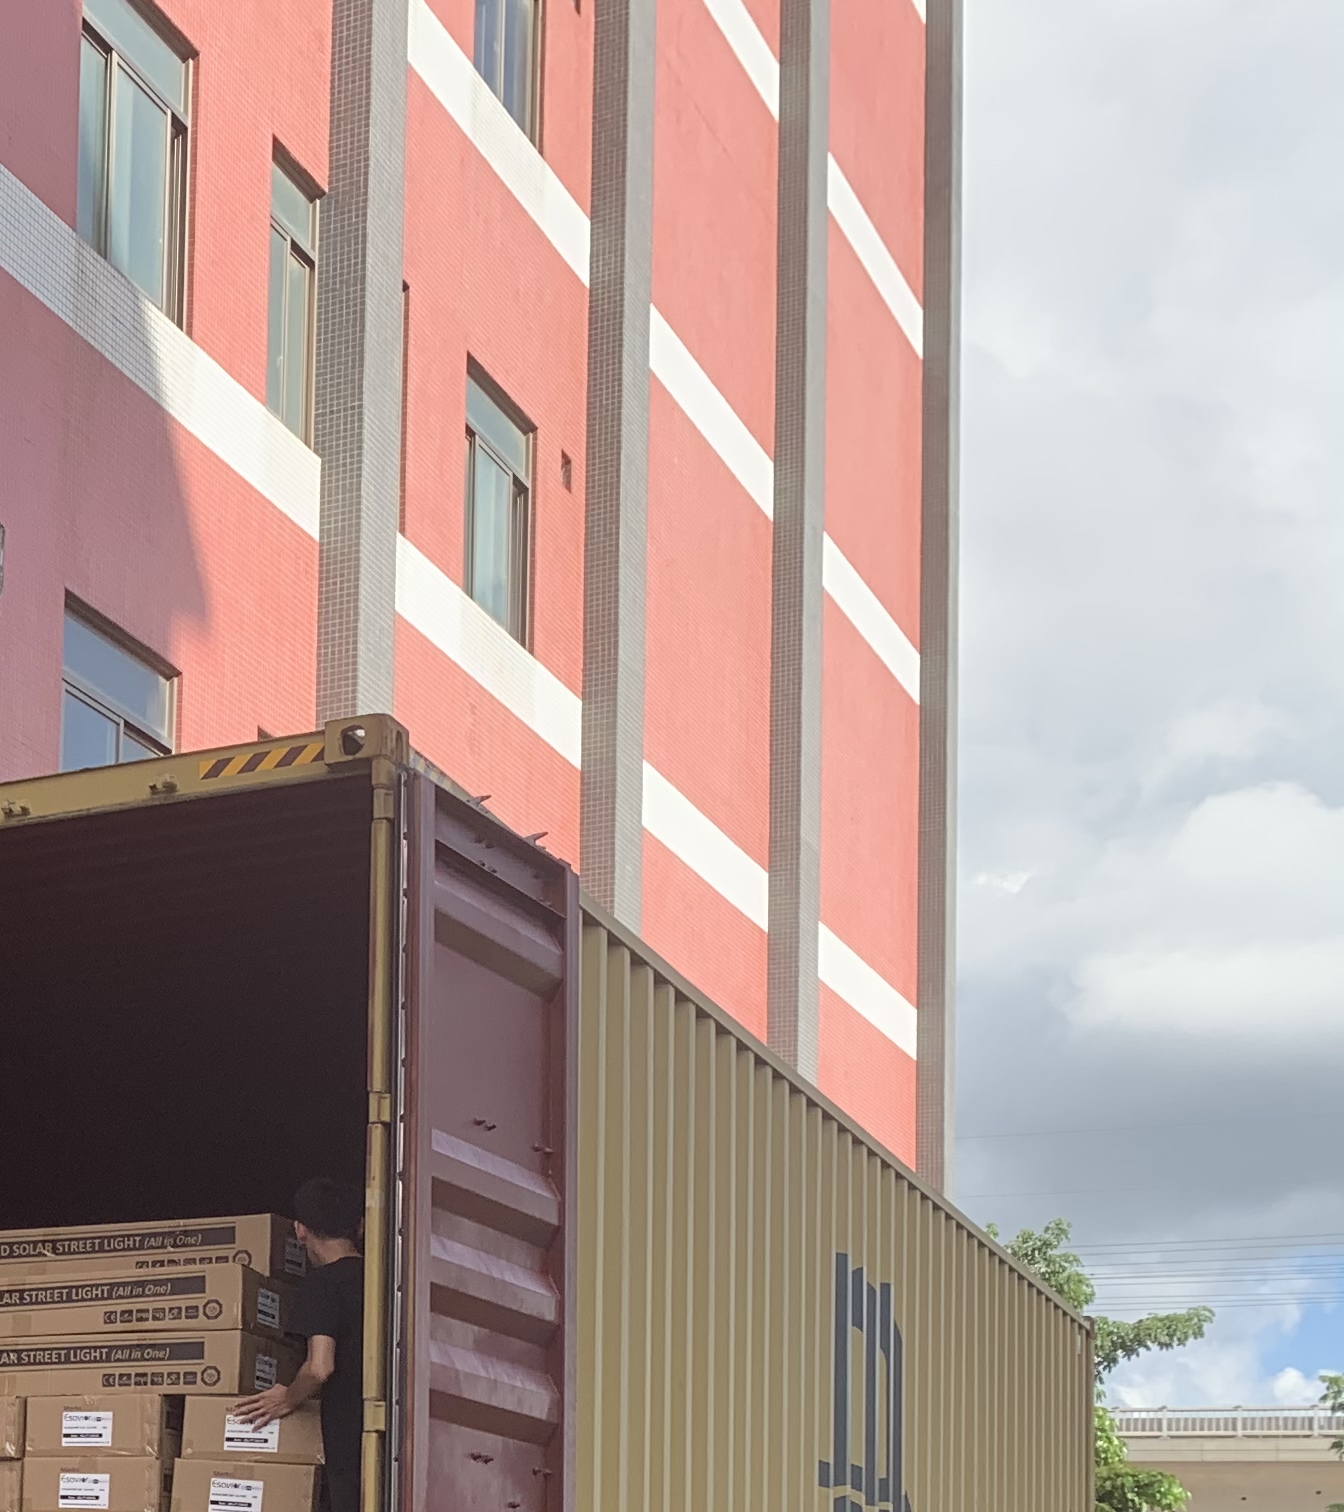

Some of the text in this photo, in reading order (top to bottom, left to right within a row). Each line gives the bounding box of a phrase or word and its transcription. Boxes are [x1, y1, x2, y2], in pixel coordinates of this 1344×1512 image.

[13, 1242, 52, 1256] SOLAR
[56, 1239, 99, 1253] STREET
[104, 1236, 141, 1250] LIGHT
[176, 1234, 201, 1246] One)
[23, 1288, 67, 1303] STREET
[72, 1286, 110, 1300] LIGHT
[145, 1283, 171, 1294] One)
[21, 1350, 66, 1364] STREET
[70, 1348, 109, 1361] LIGHT
[144, 1348, 169, 1359] One)
